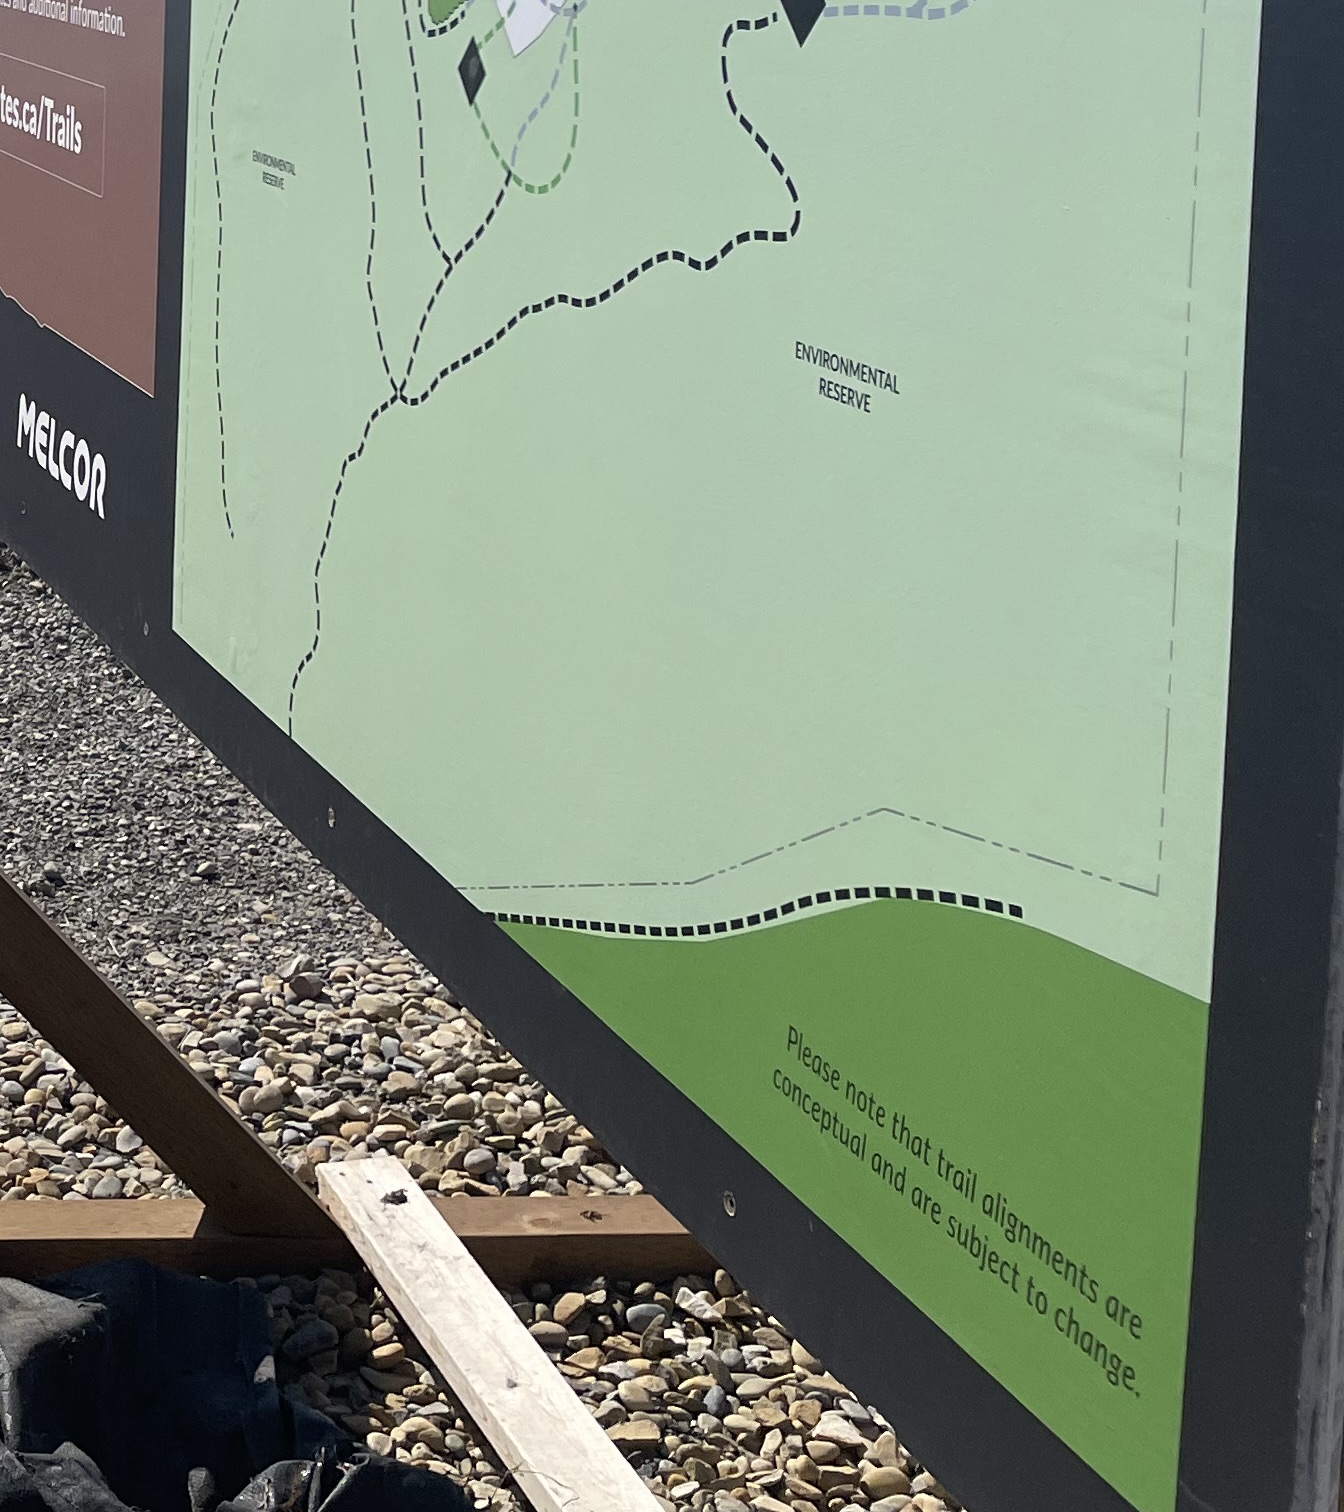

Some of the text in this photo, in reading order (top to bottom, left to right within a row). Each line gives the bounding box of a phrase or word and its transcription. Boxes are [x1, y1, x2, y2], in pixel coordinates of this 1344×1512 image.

[795, 340, 900, 395] ENVIRONMENTAL
[819, 377, 872, 413] RESERVE
[16, 393, 106, 519] MELCOR
[773, 1068, 1142, 1398] conceptual and are subject to change.
[787, 1025, 1144, 1340] Please note that trail alignments are
